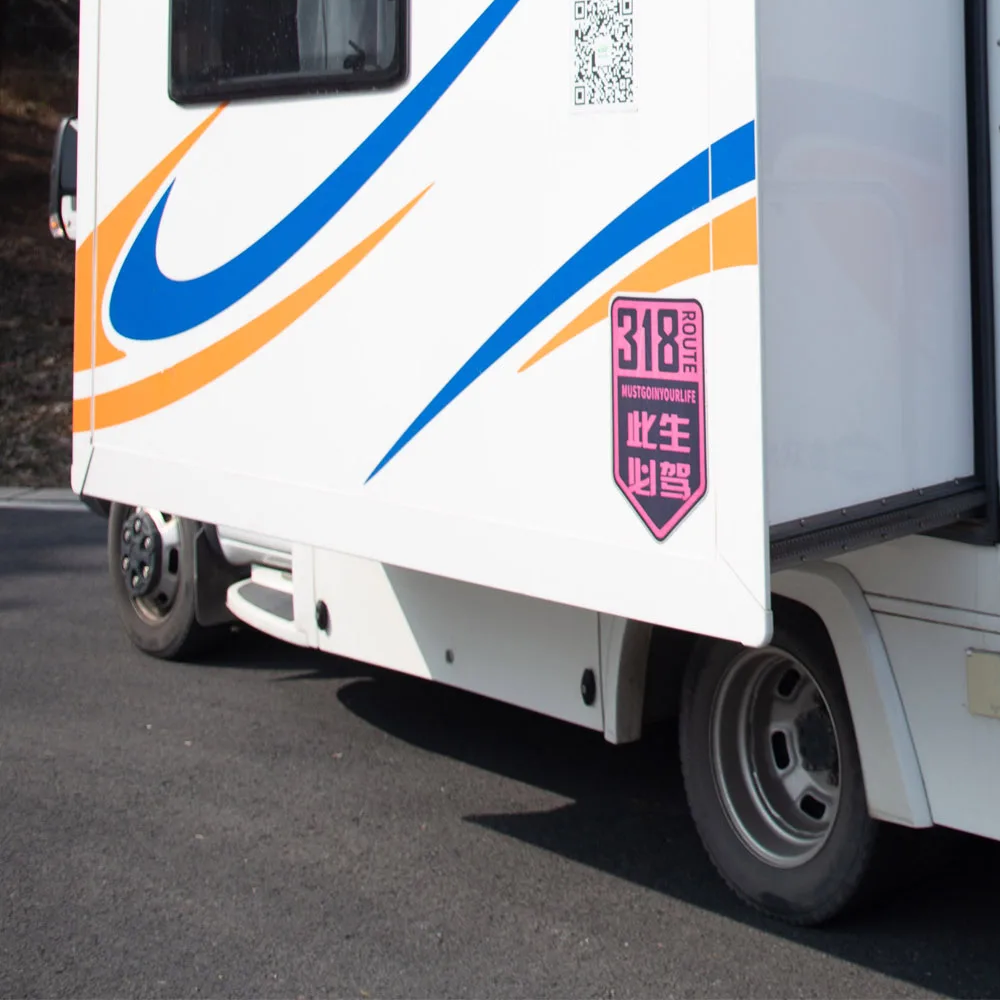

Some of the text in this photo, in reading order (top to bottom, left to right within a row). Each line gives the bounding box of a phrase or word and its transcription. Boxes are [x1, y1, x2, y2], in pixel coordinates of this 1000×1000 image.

[617, 307, 680, 373] 318
[681, 310, 698, 374] ROUTE
[621, 383, 697, 404] MUSTGOINYOURLIFE
[626, 410, 692, 454] 此生
[627, 456, 692, 501] 必驾
